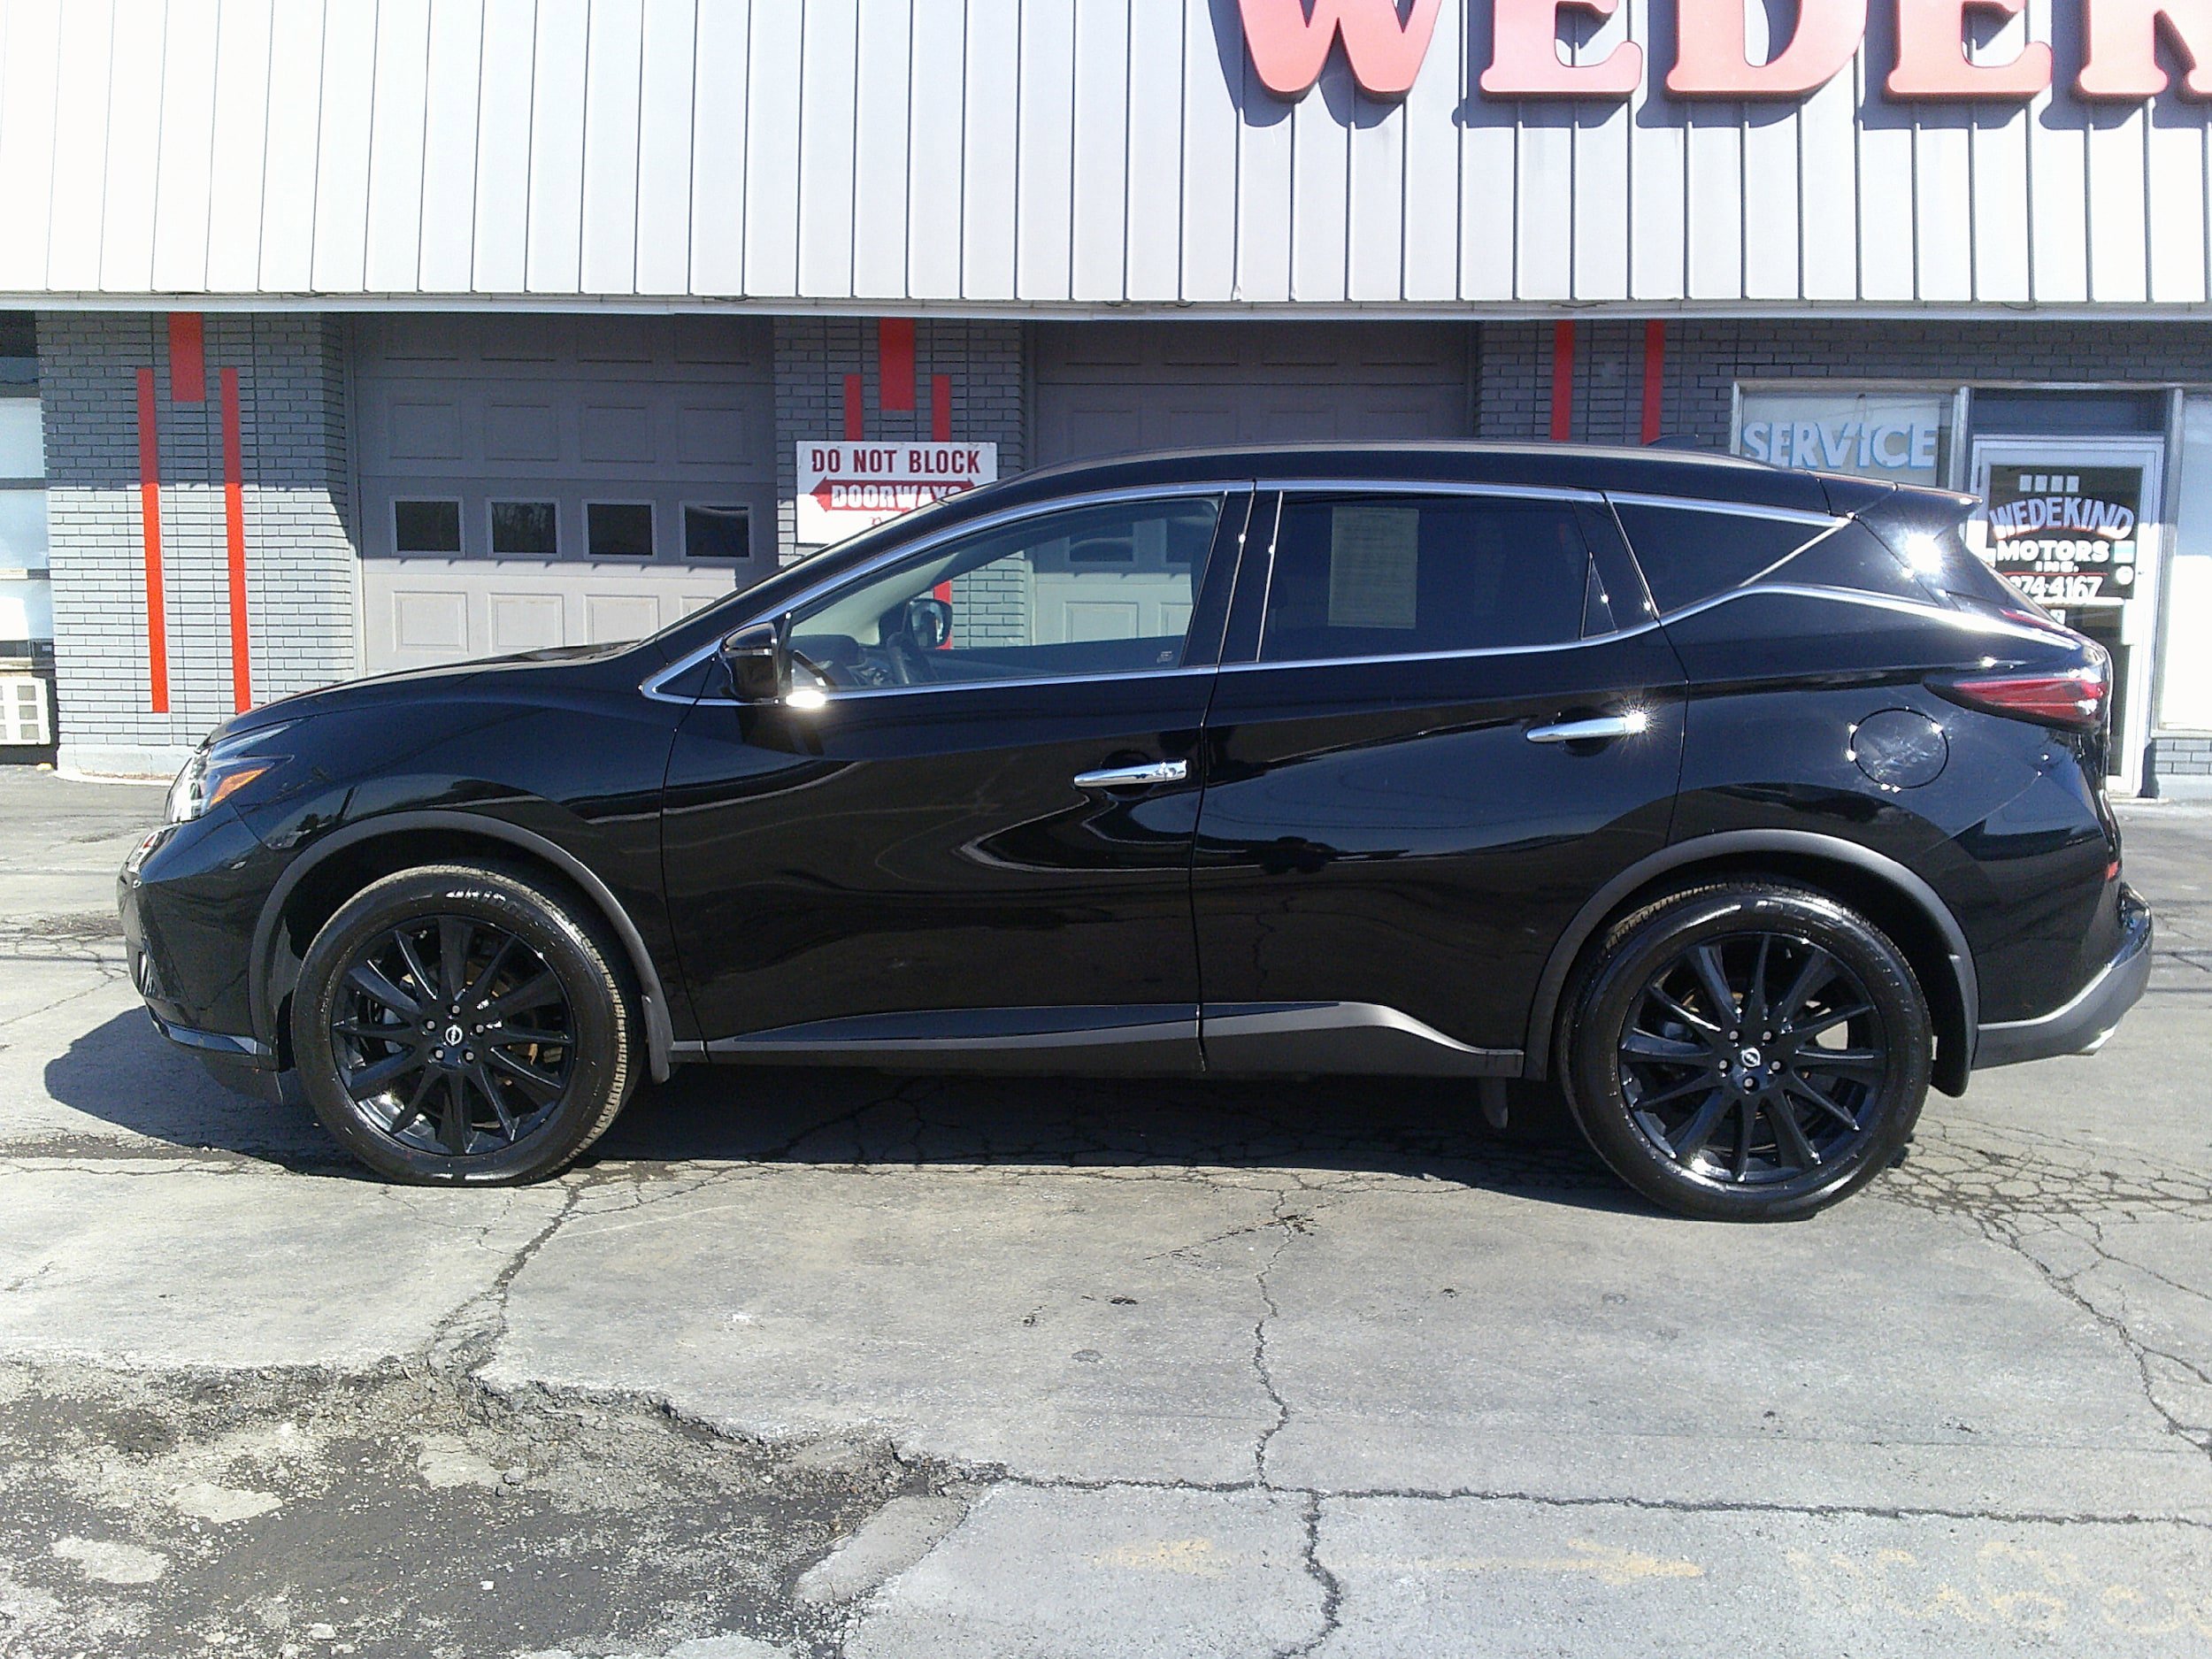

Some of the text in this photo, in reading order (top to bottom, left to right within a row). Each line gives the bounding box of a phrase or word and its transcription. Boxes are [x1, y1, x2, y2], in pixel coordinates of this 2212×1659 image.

[812, 449, 980, 473] DO NOT BLOCK
[1742, 421, 1937, 469] SERVICE
[1989, 496, 2134, 541] WEDEKIND
[1997, 540, 2109, 563] MOTORS
